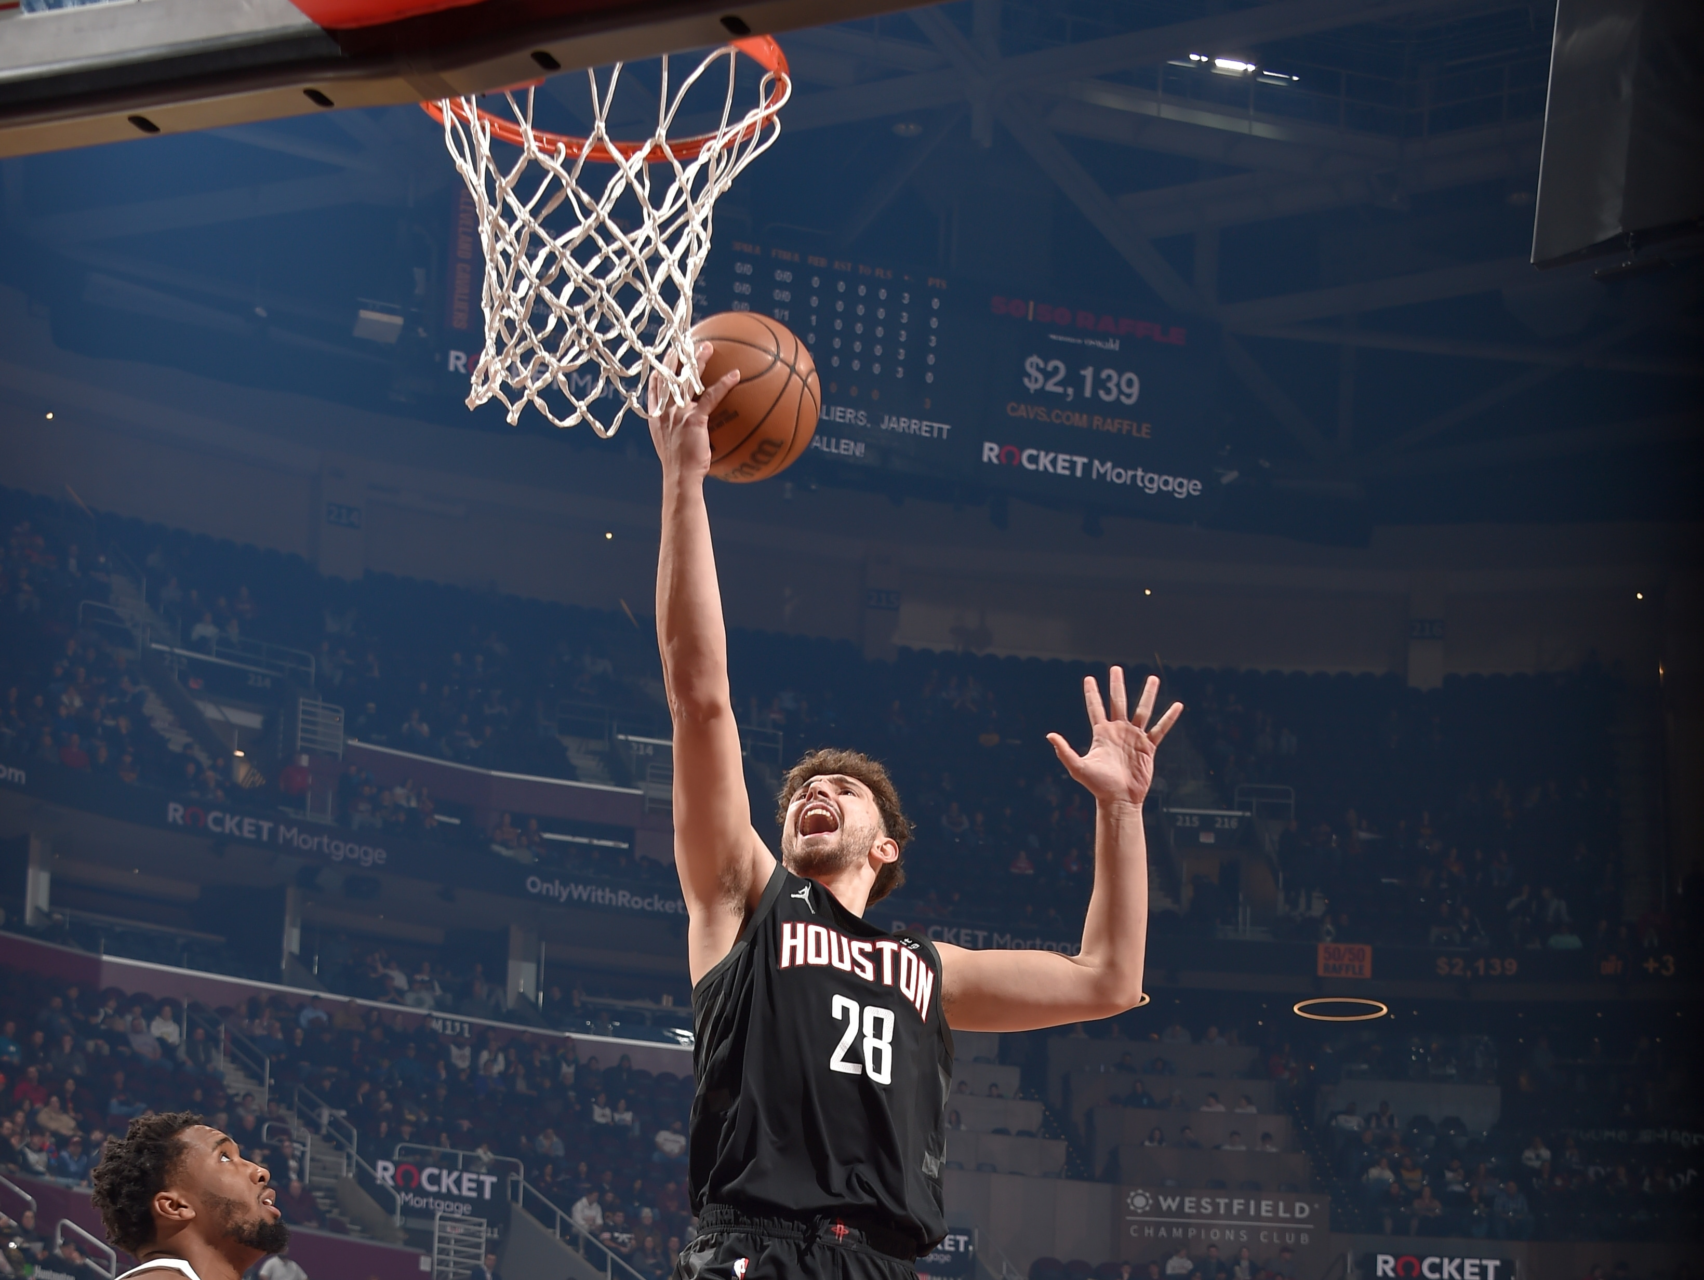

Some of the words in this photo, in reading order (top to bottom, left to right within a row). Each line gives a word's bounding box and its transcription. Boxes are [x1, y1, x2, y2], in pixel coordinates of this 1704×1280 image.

[901, 292, 910, 304] 3
[900, 311, 909, 324] 3
[1076, 310, 1187, 346] RAFFLE
[898, 330, 907, 342] 3
[897, 348, 906, 360] 3
[895, 366, 904, 379] 3
[1022, 353, 1141, 406] $2,139
[880, 413, 952, 441] JARRETT
[1006, 402, 1088, 430] CAVS.COM
[1091, 415, 1152, 439] RAFFLE
[981, 440, 1089, 479] ROCKET
[1091, 458, 1203, 499] Mortgage
[329, 505, 360, 526] 214
[167, 802, 274, 842] ROCKET
[277, 824, 388, 867] Mortgage
[1324, 946, 1365, 963] 50/50
[1436, 956, 1519, 979] $2,139
[1642, 954, 1675, 977] +3
[779, 920, 936, 1025] HOUSTON
[1323, 963, 1365, 976] RAFFLE
[829, 992, 896, 1086] 28
[375, 1159, 498, 1201] ROCKET
[400, 1191, 472, 1215] Mortgage
[1157, 1194, 1311, 1219] WESTFIELD
[1129, 1225, 1249, 1242] CHAMPIONS
[1259, 1231, 1311, 1245] CLUB
